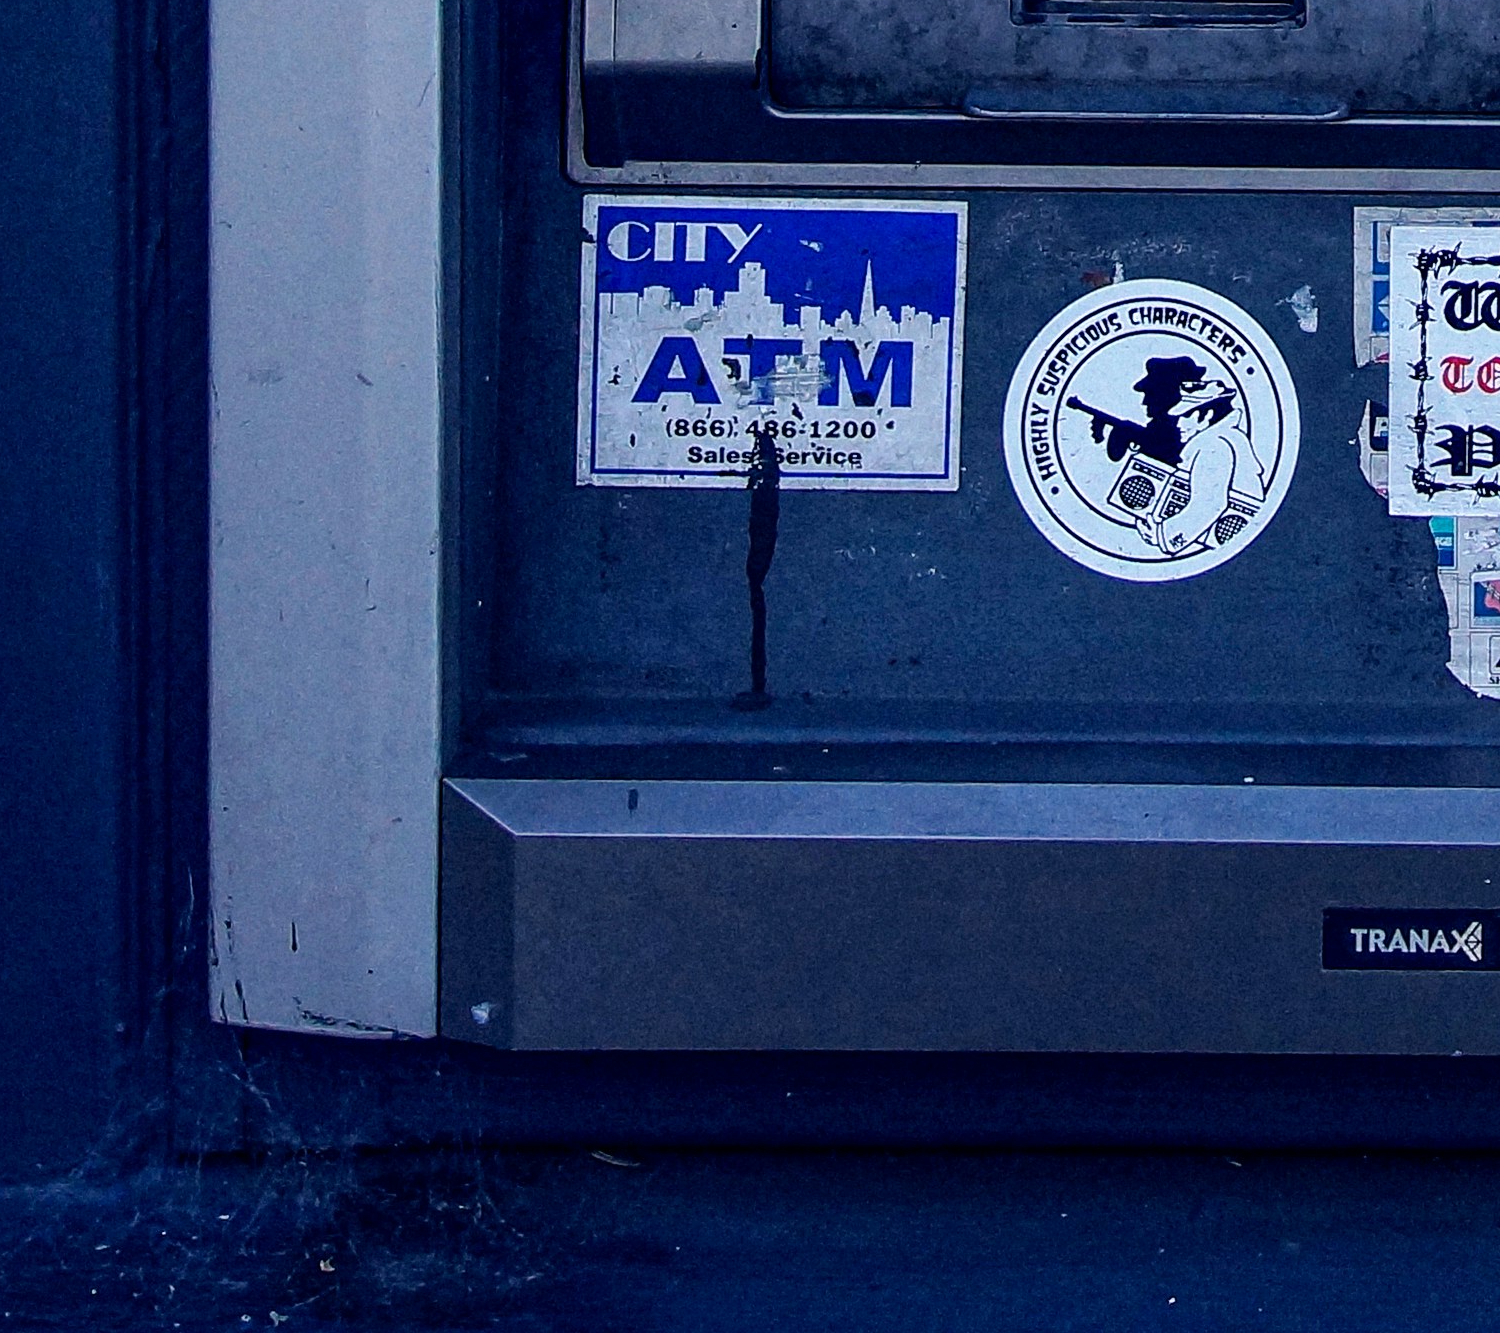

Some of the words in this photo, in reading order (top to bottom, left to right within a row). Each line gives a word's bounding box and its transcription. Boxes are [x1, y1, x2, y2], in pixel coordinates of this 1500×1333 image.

[607, 220, 763, 264] CITY
[1037, 312, 1123, 397] SUSPICIOUS
[1129, 306, 1247, 365] CHARACTERS
[631, 335, 915, 408] ATM
[666, 418, 734, 440] (866)
[745, 418, 877, 440] 486-1200
[1031, 403, 1058, 481] HIGHLY
[688, 445, 753, 466] Sales
[774, 448, 864, 466] Service
[1350, 924, 1477, 957] TRANAX
